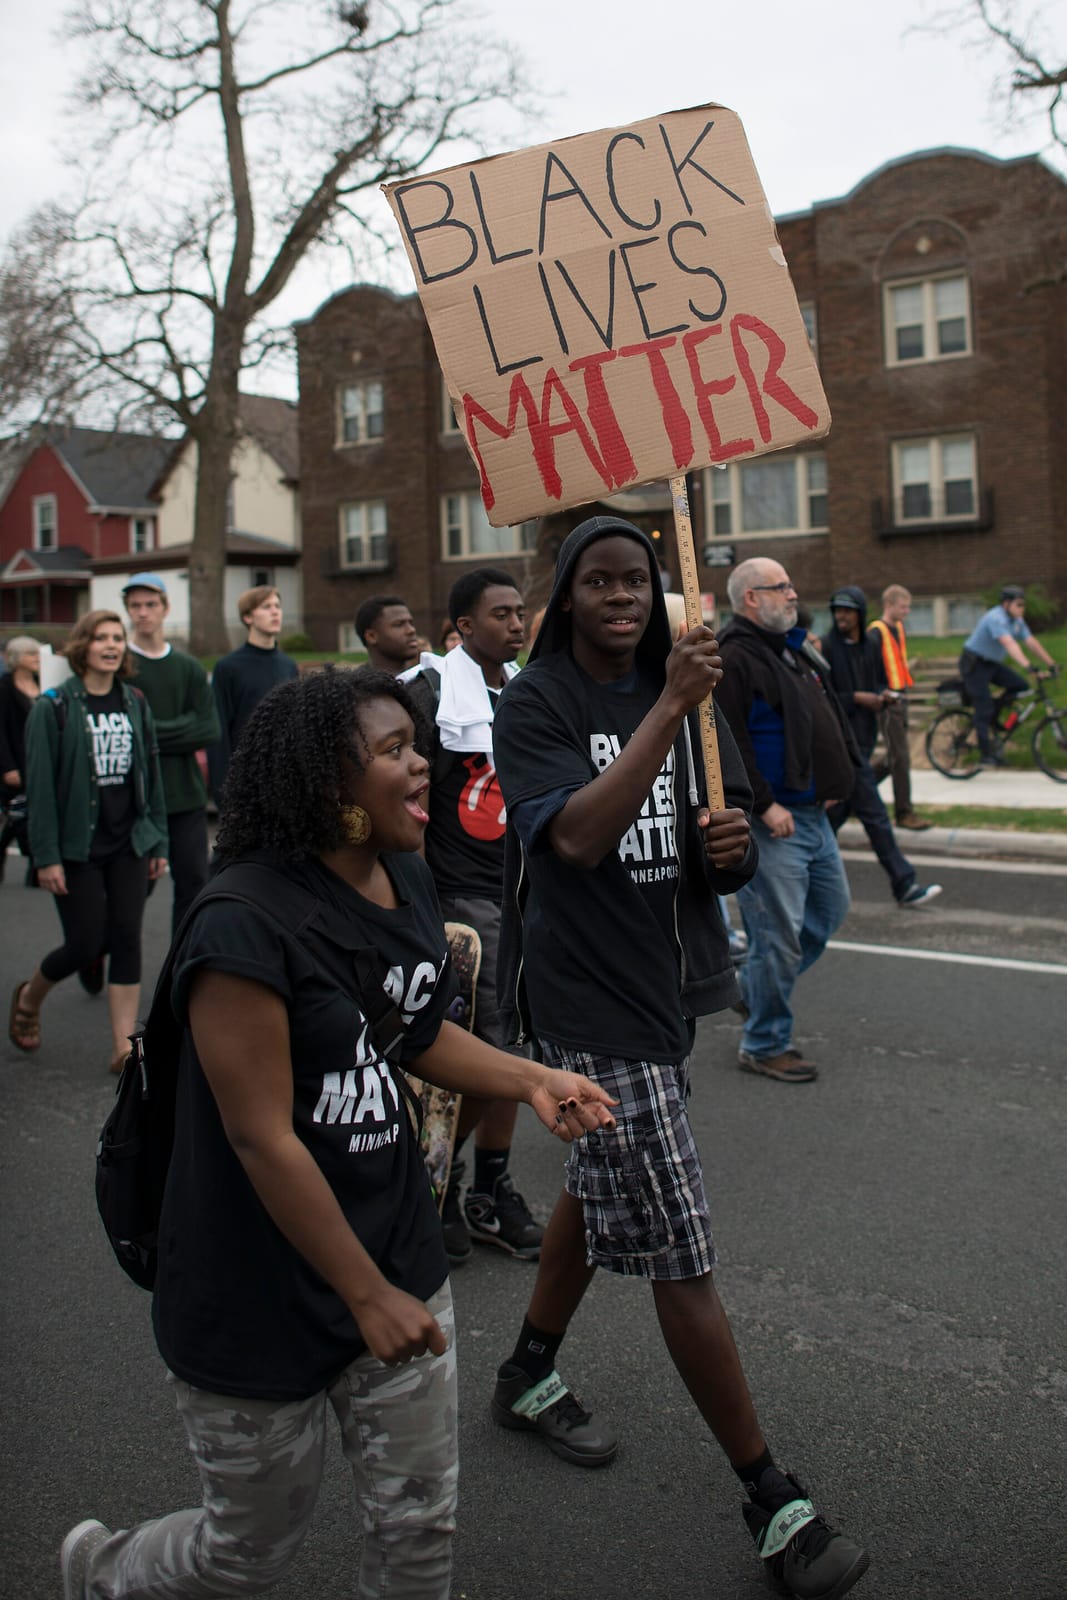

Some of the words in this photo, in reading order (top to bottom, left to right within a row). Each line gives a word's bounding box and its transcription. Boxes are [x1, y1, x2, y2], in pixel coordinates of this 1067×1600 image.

[394, 120, 745, 284] BLACK
[473, 220, 727, 376] LIVES
[463, 313, 818, 511] MATTER
[627, 864, 679, 884] NNEAPOLIS
[382, 951, 447, 1011] AC
